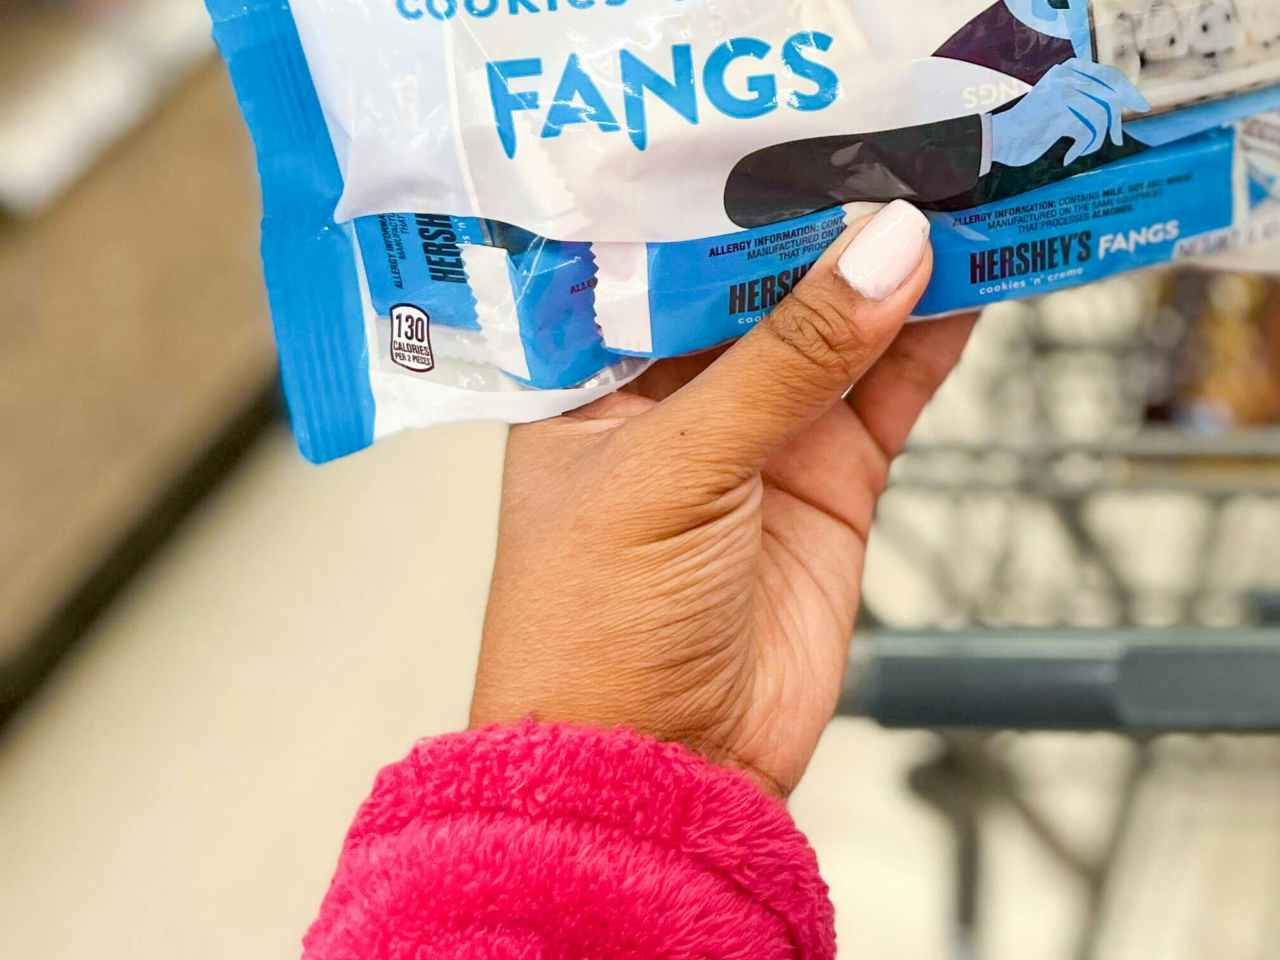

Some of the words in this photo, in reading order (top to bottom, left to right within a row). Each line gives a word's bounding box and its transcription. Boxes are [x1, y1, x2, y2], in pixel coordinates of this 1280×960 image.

[485, 30, 842, 161] FANGS
[708, 240, 755, 257] ALLERGY
[747, 232, 819, 260] MANUFACTURED
[969, 229, 1093, 285] HERSHEY'S
[1098, 219, 1181, 259] FANGS
[979, 277, 1026, 296] cookies
[1047, 266, 1084, 282] creme
[395, 312, 425, 343] 130
[394, 341, 430, 356] CALORIES
